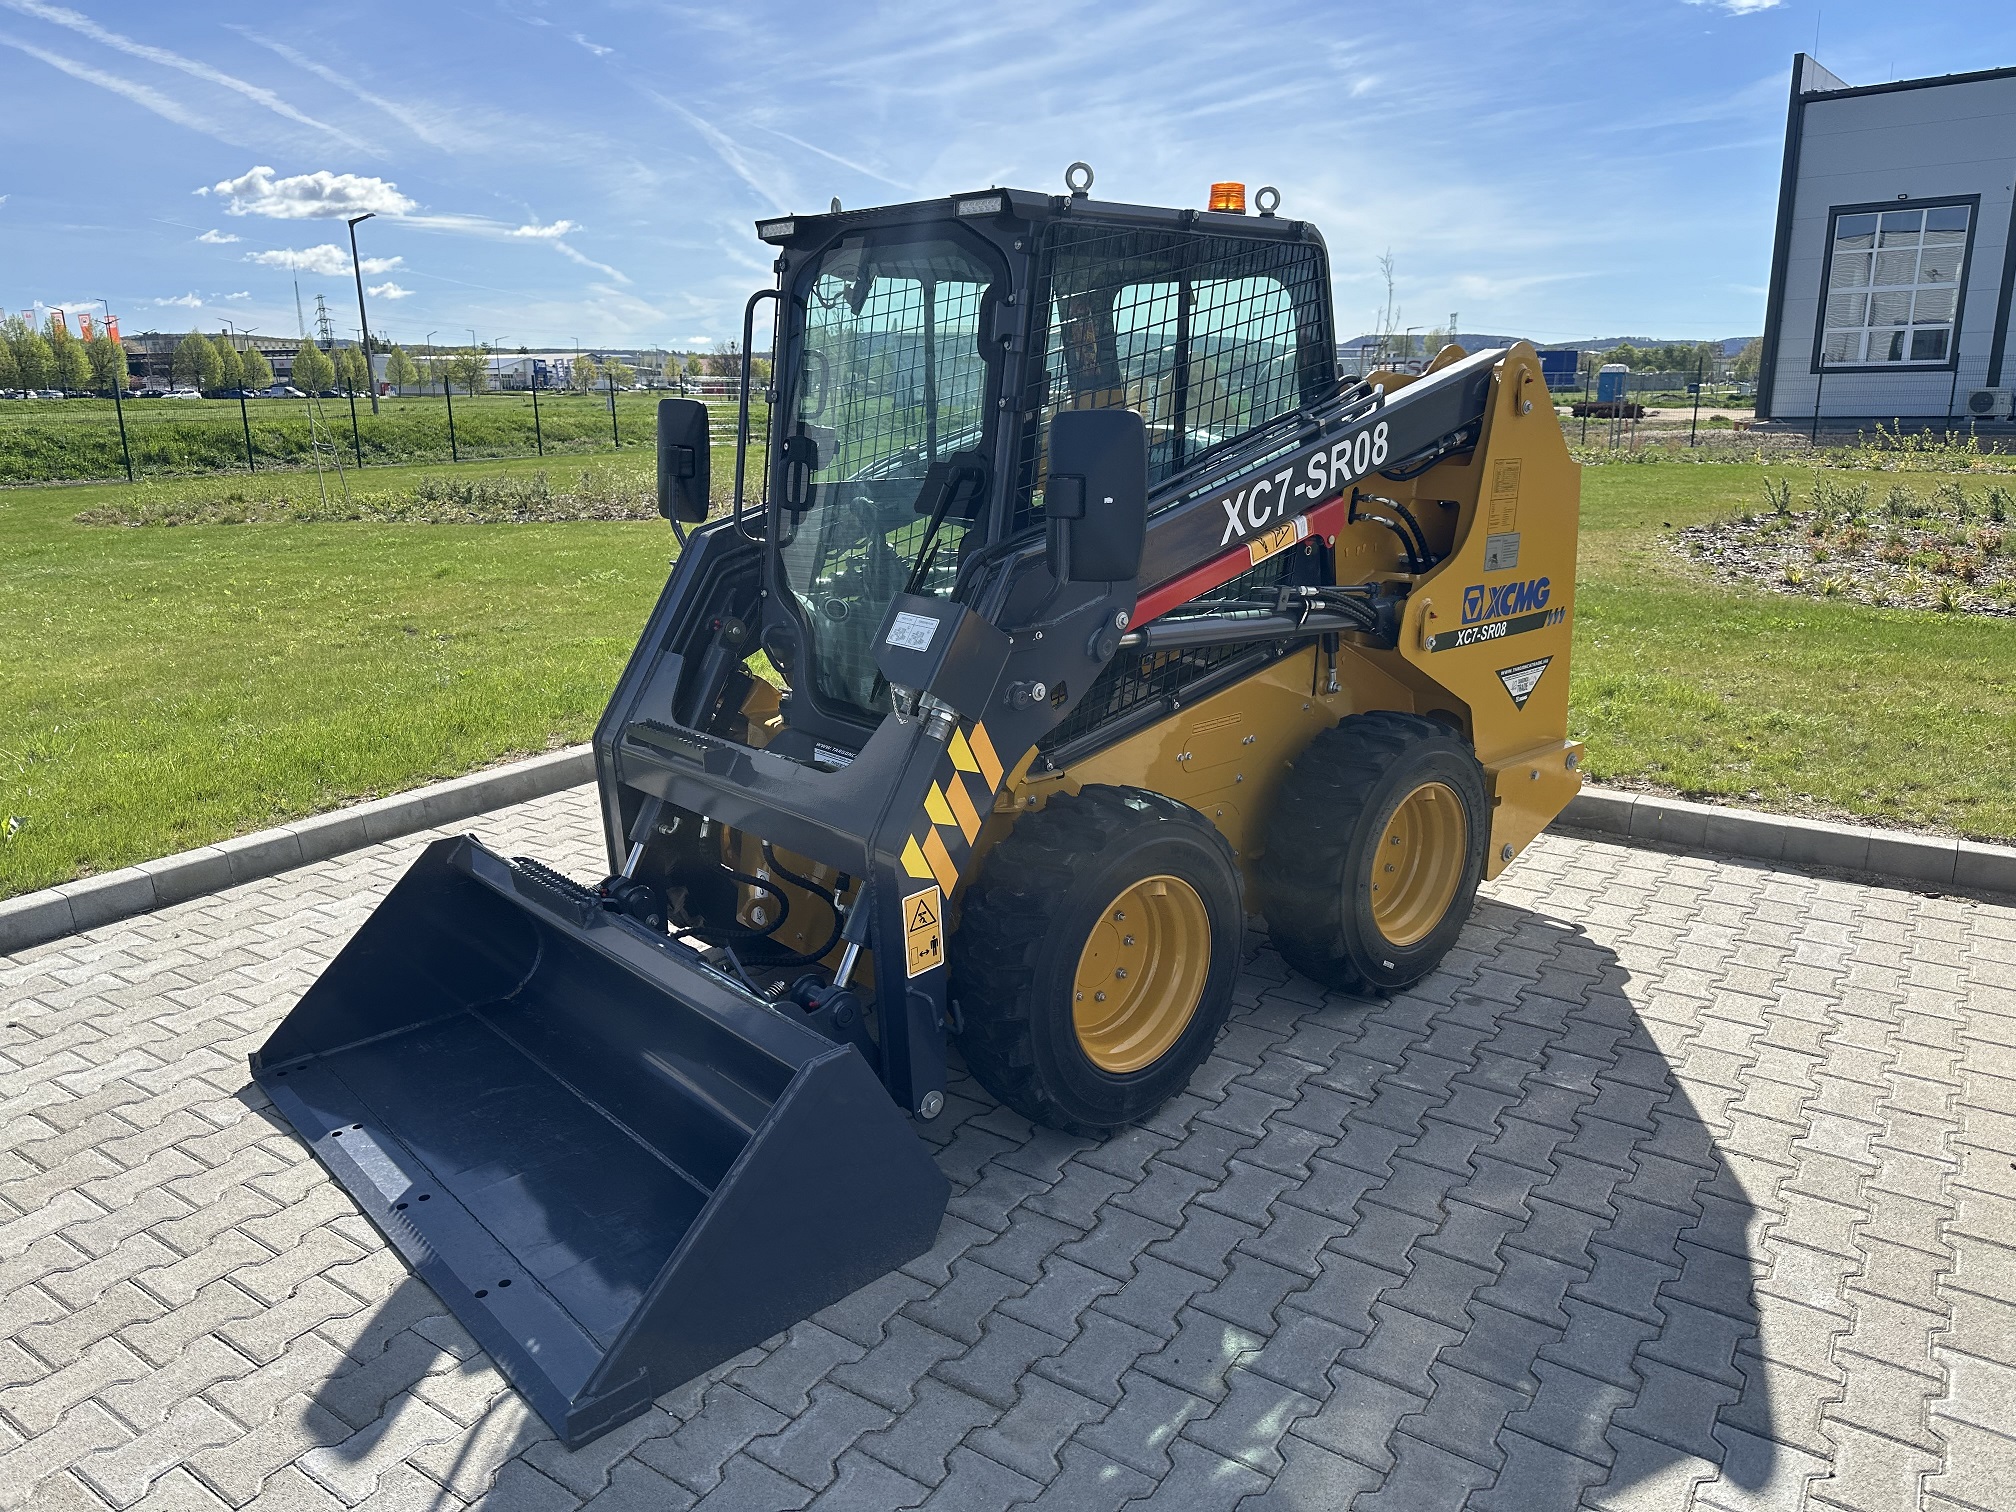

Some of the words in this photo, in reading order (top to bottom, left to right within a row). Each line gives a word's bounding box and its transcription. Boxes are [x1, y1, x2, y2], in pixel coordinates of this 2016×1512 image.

[1220, 421, 1388, 546] XC7-SR08
[1482, 577, 1550, 620] XCMG
[1455, 622, 1507, 646] XC7-SR08
